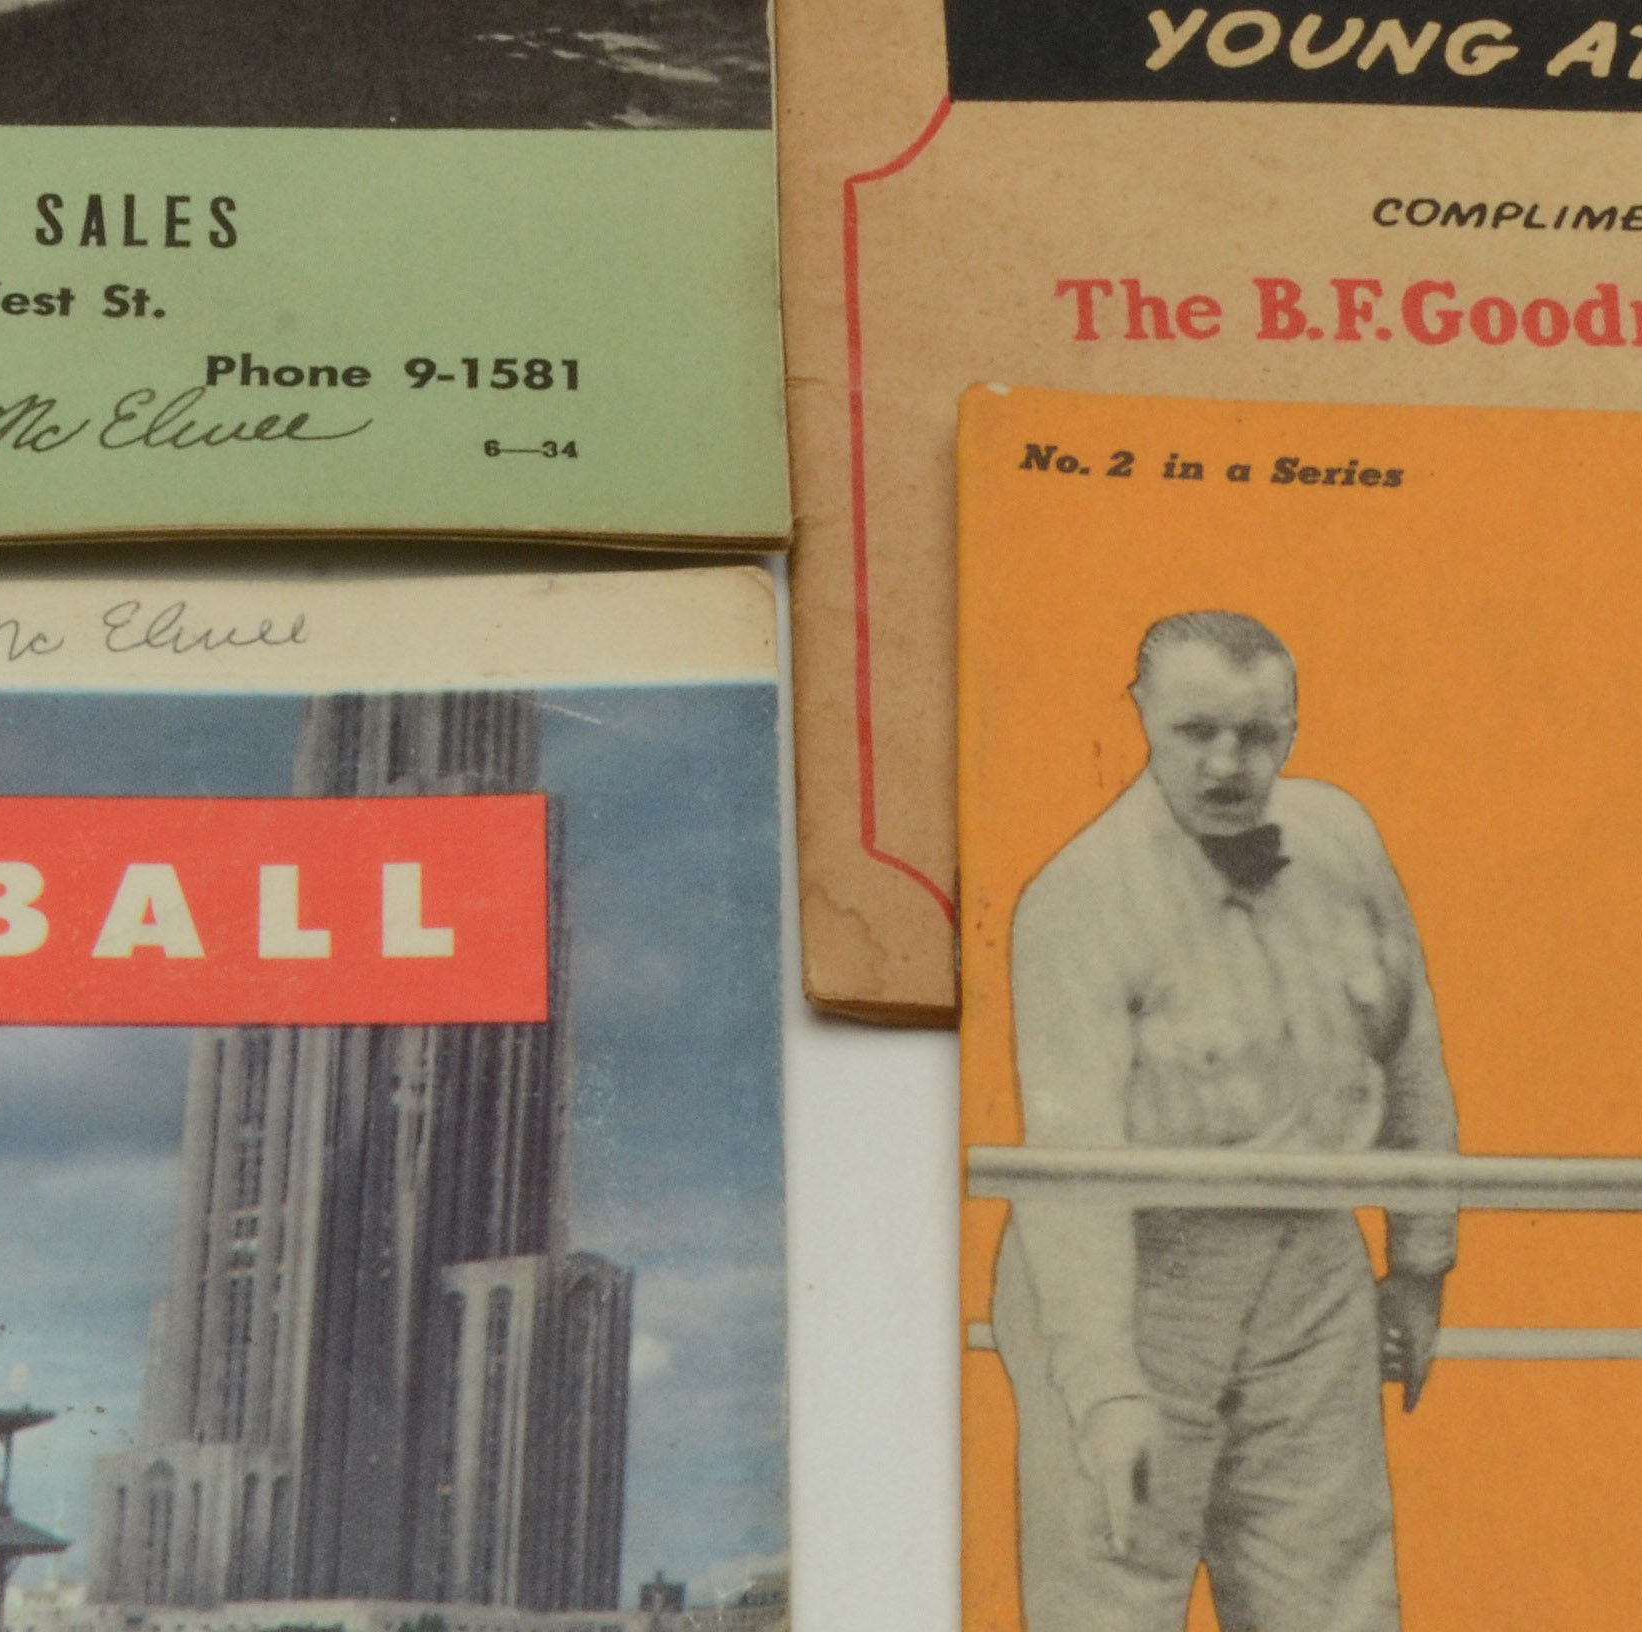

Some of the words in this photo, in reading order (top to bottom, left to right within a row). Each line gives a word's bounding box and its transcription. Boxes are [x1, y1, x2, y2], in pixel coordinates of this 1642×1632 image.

[1145, 7, 1520, 77] YOUNG
[35, 192, 238, 250] SALES
[102, 283, 166, 320] St.
[1054, 277, 1223, 343] The
[203, 351, 372, 391] Phone
[403, 356, 579, 391] 9-1581
[1018, 442, 1091, 476] No.
[1105, 449, 1136, 478] 2
[1161, 452, 1205, 481] in
[1225, 463, 1252, 483] a
[1270, 456, 1405, 489] Series
